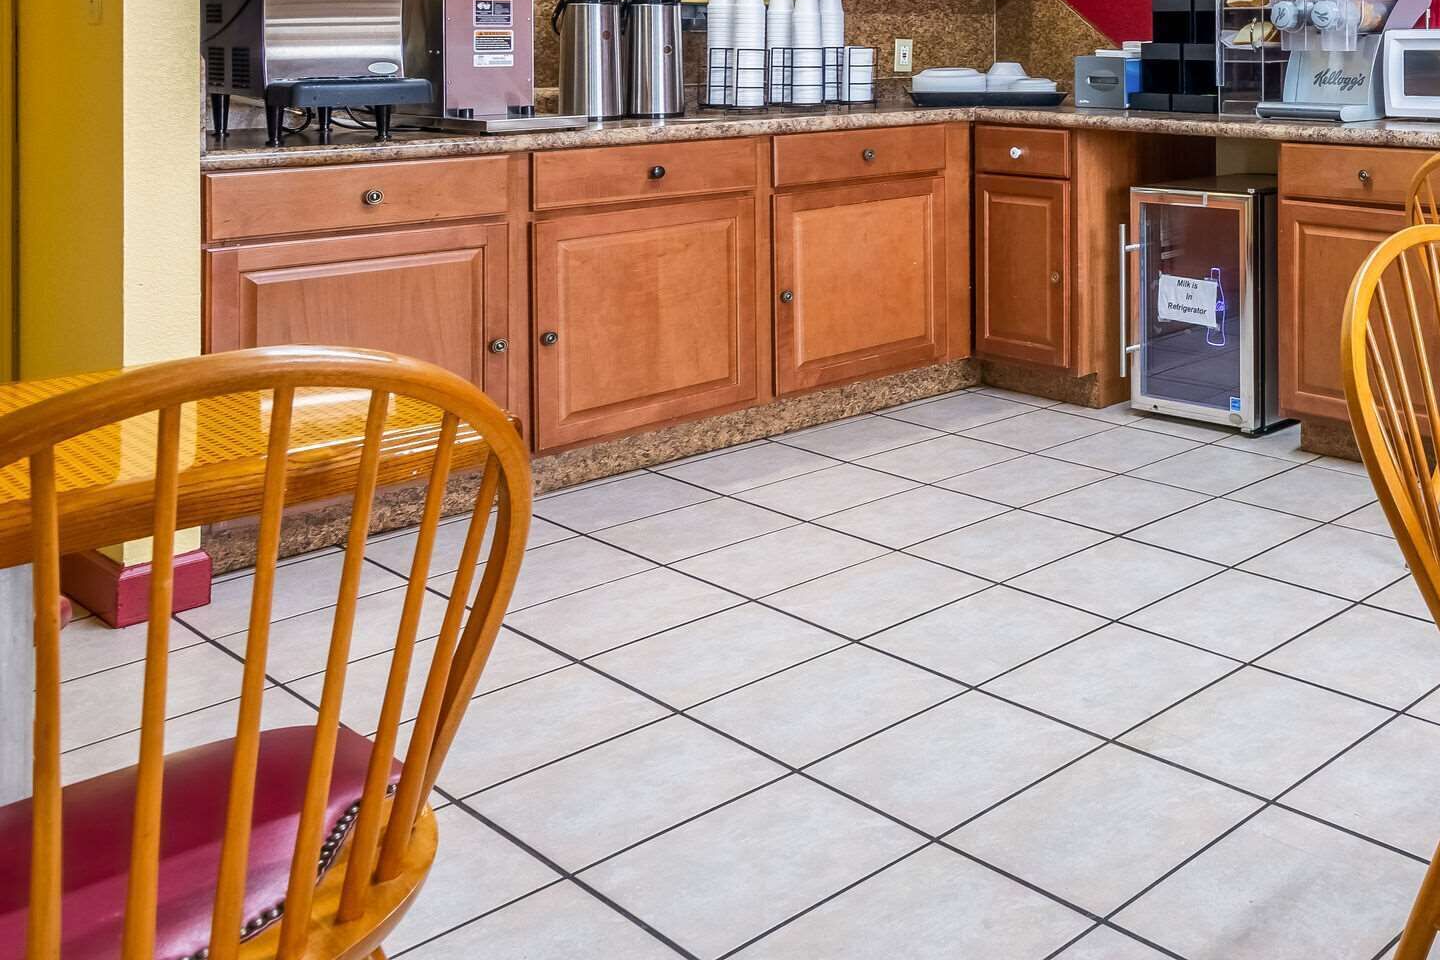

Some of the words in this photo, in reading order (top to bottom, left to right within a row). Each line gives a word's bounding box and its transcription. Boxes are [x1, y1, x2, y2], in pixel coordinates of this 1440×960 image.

[1313, 68, 1366, 91] Kellogg's
[1176, 279, 1191, 289] Milk
[1191, 281, 1199, 289] is
[1168, 302, 1207, 315] Refrigerator
